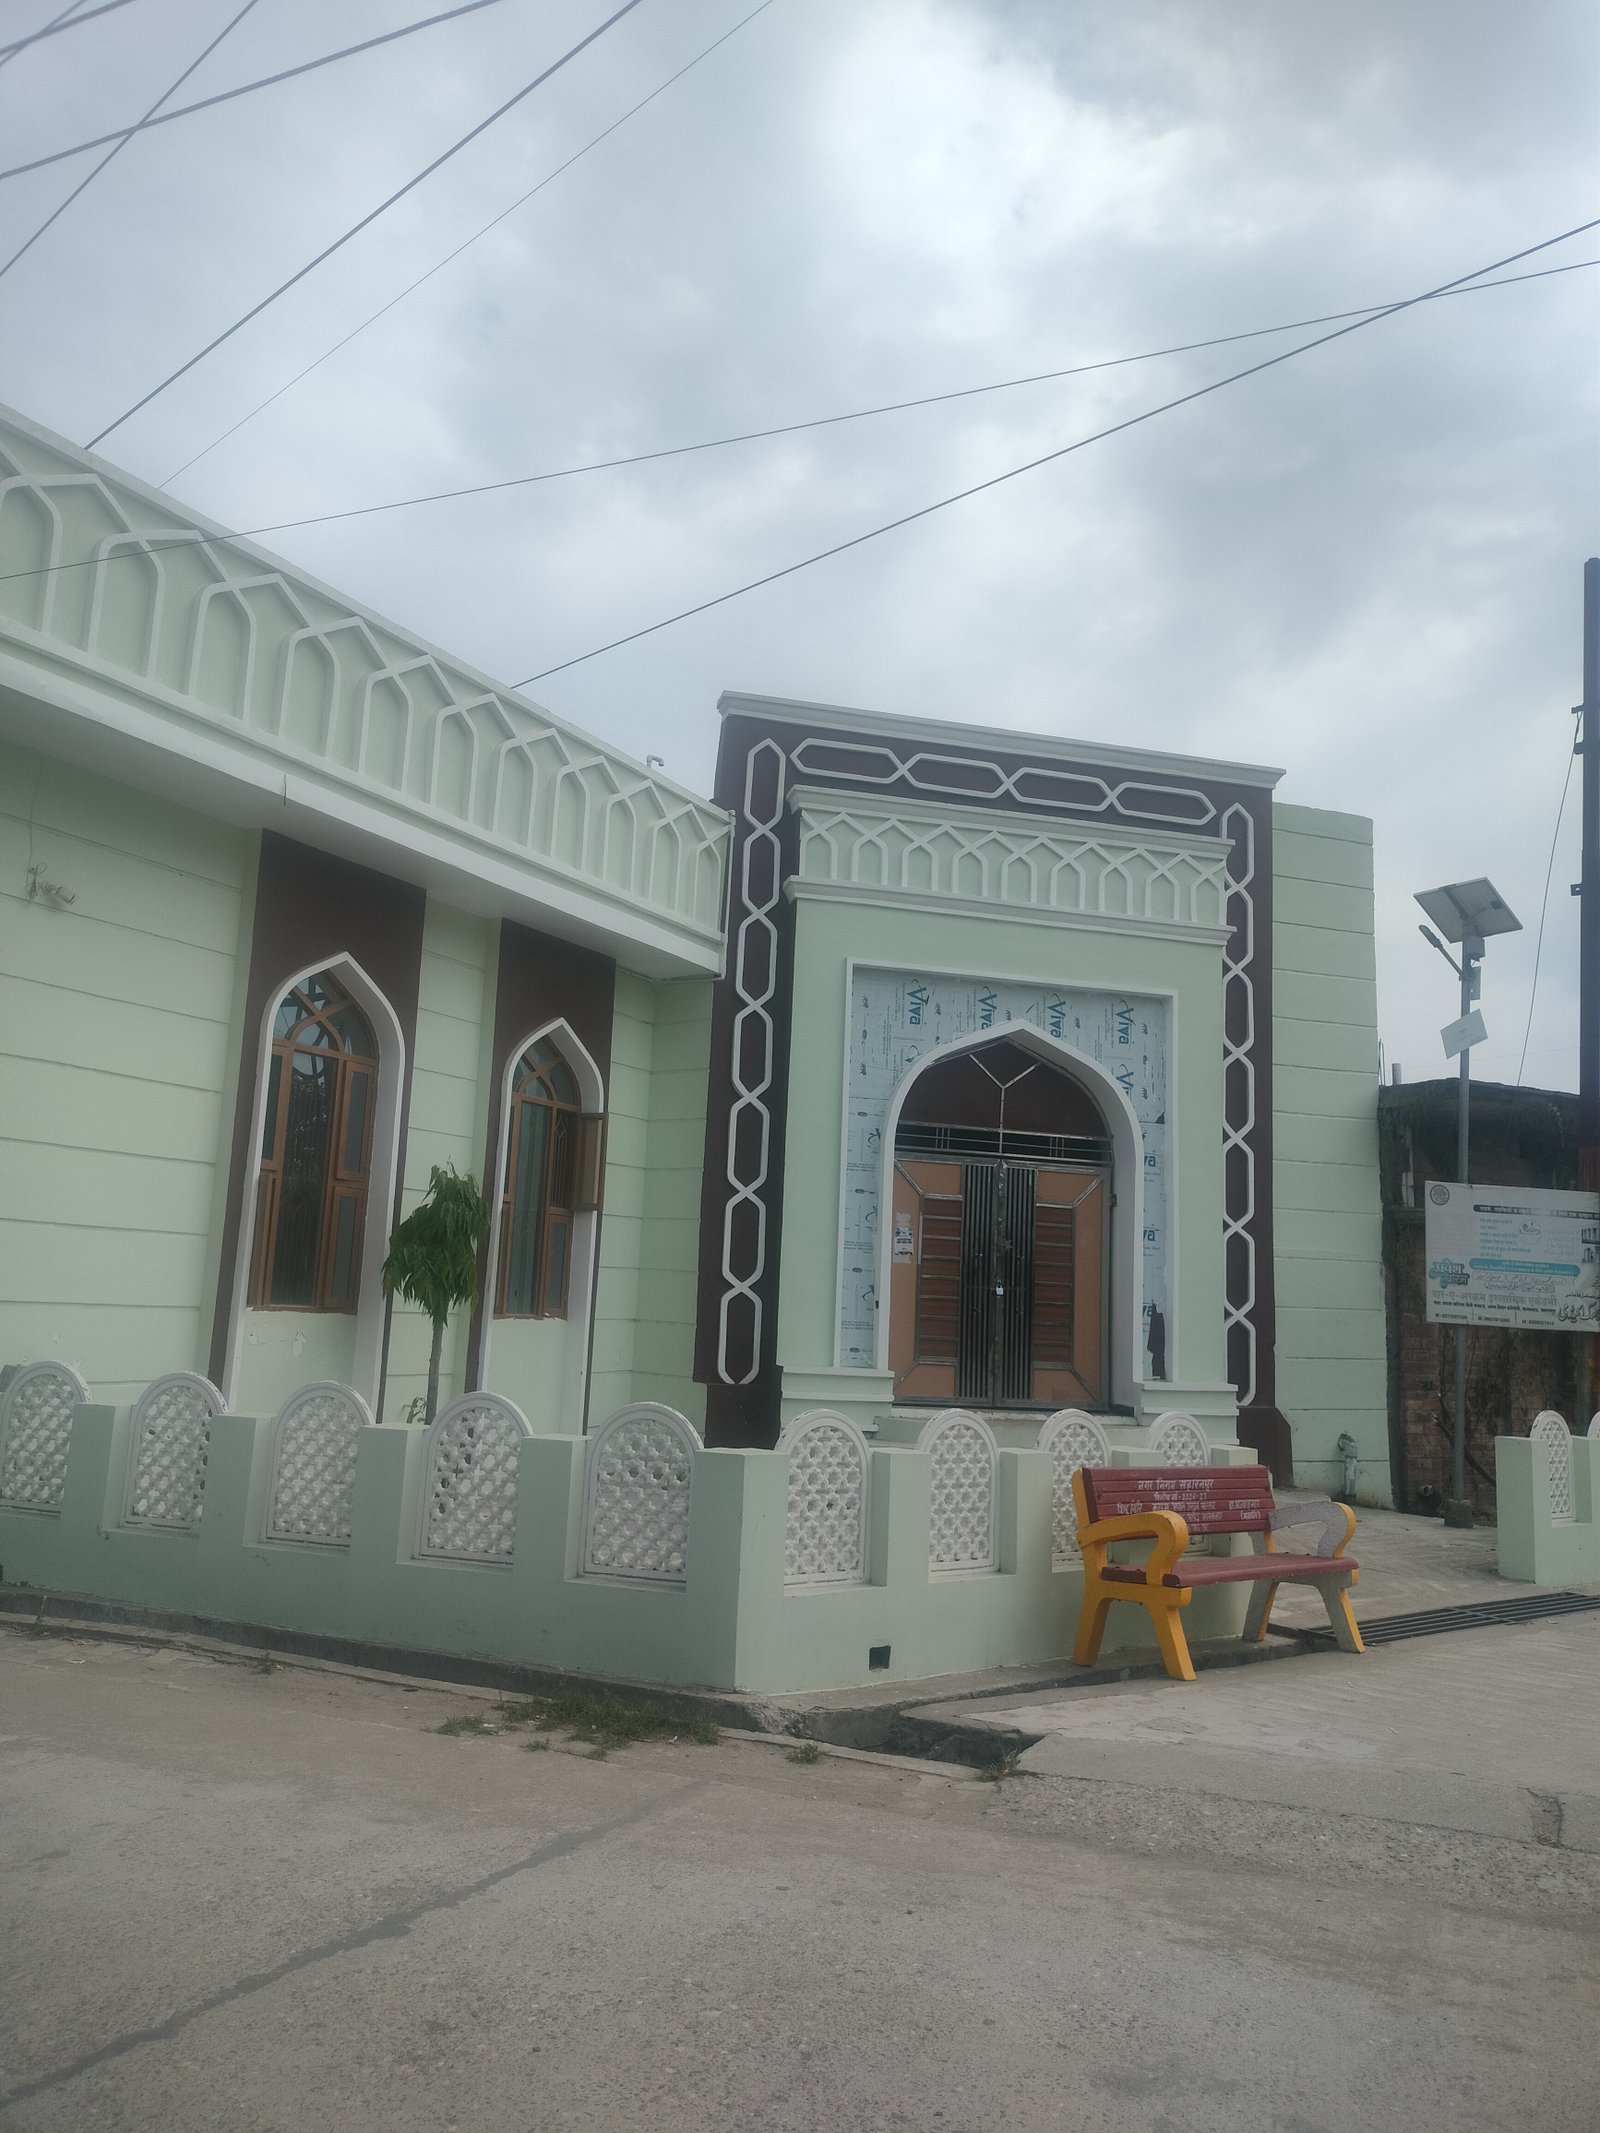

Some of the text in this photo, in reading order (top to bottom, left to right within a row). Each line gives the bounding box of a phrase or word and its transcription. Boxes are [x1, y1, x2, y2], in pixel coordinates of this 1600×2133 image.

[907, 985, 927, 1025] Viva
[1047, 1000, 1067, 1038] Viva
[1115, 1007, 1135, 1044] Viva
[1138, 1477, 1214, 1491] नगर निगम सहारनपुर
